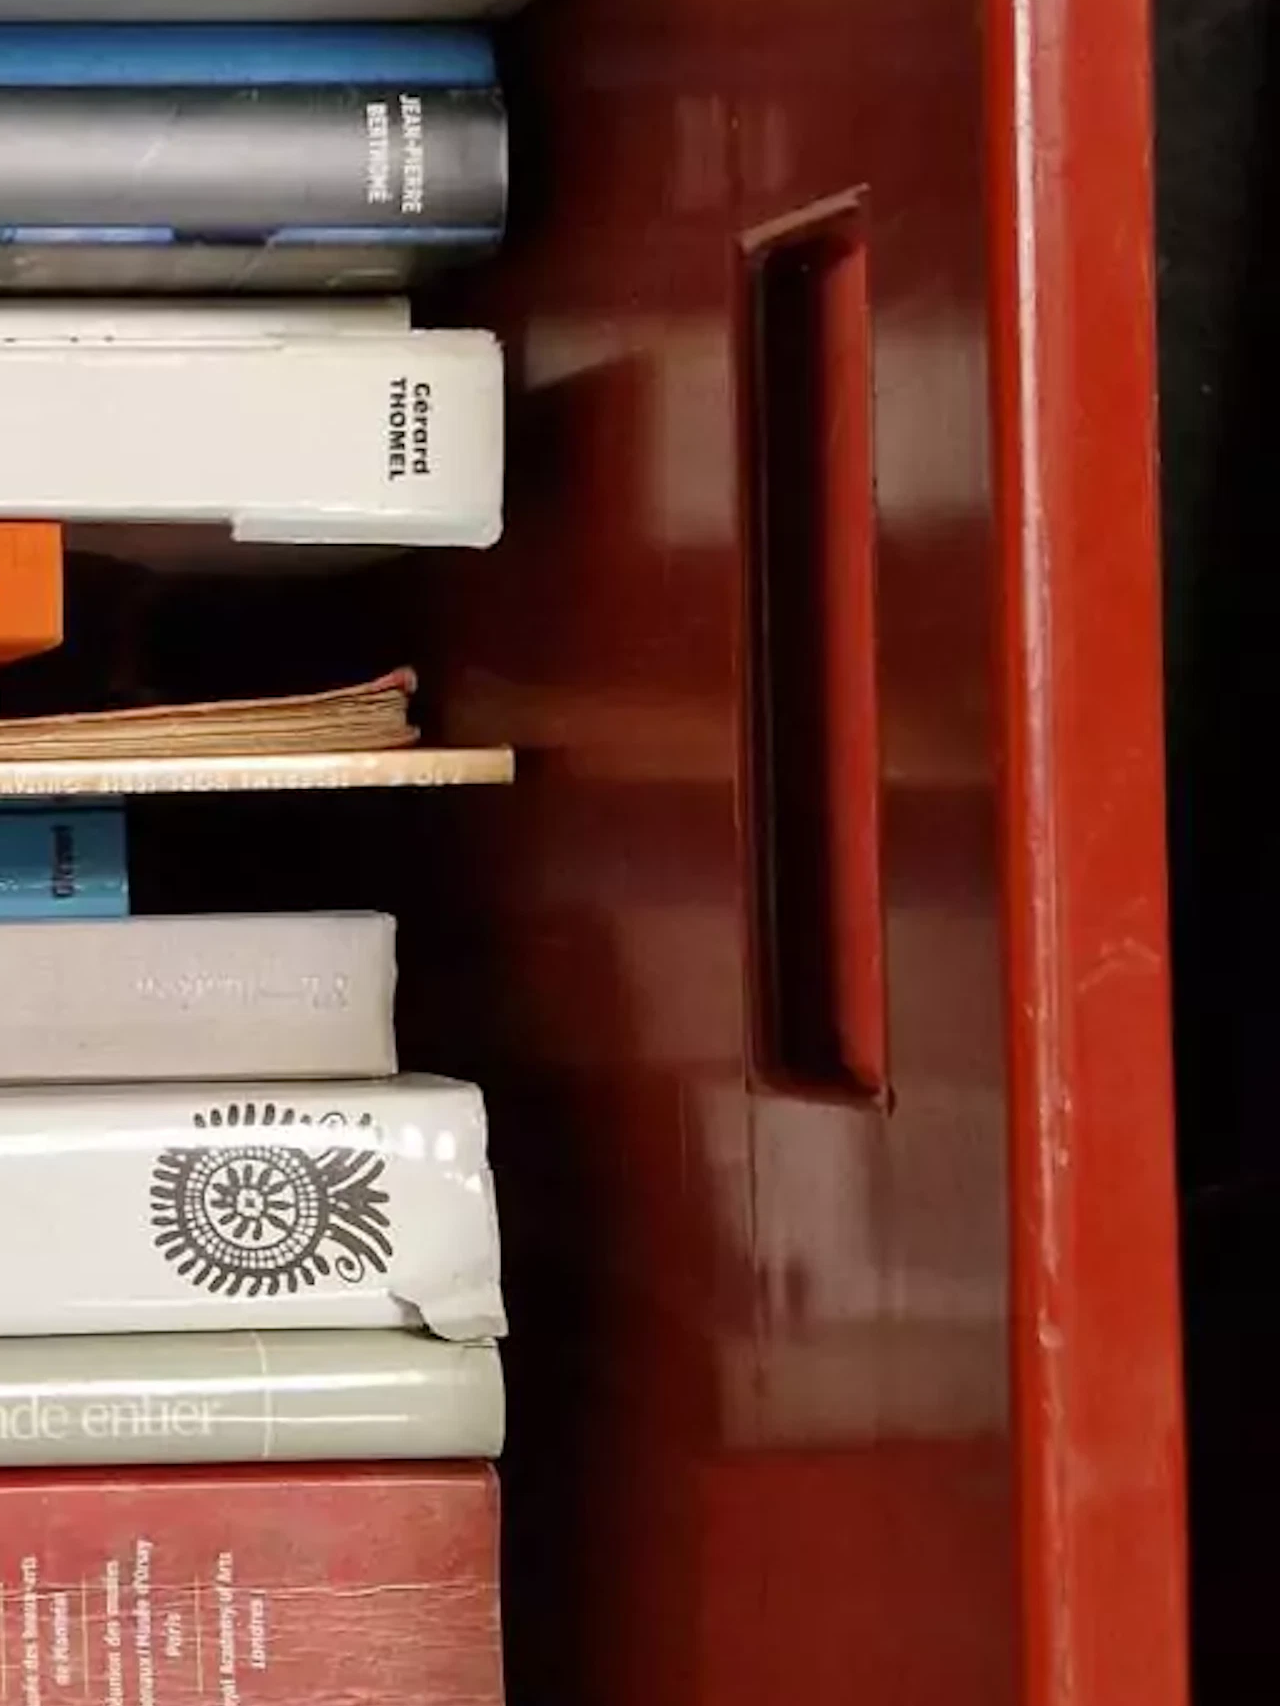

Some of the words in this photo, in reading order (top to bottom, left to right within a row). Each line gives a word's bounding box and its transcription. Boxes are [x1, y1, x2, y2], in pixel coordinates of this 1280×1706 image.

[401, 93, 423, 216] JEAN-PIERRE
[385, 376, 408, 483] THOMEL
[411, 382, 433, 475] Gérard
